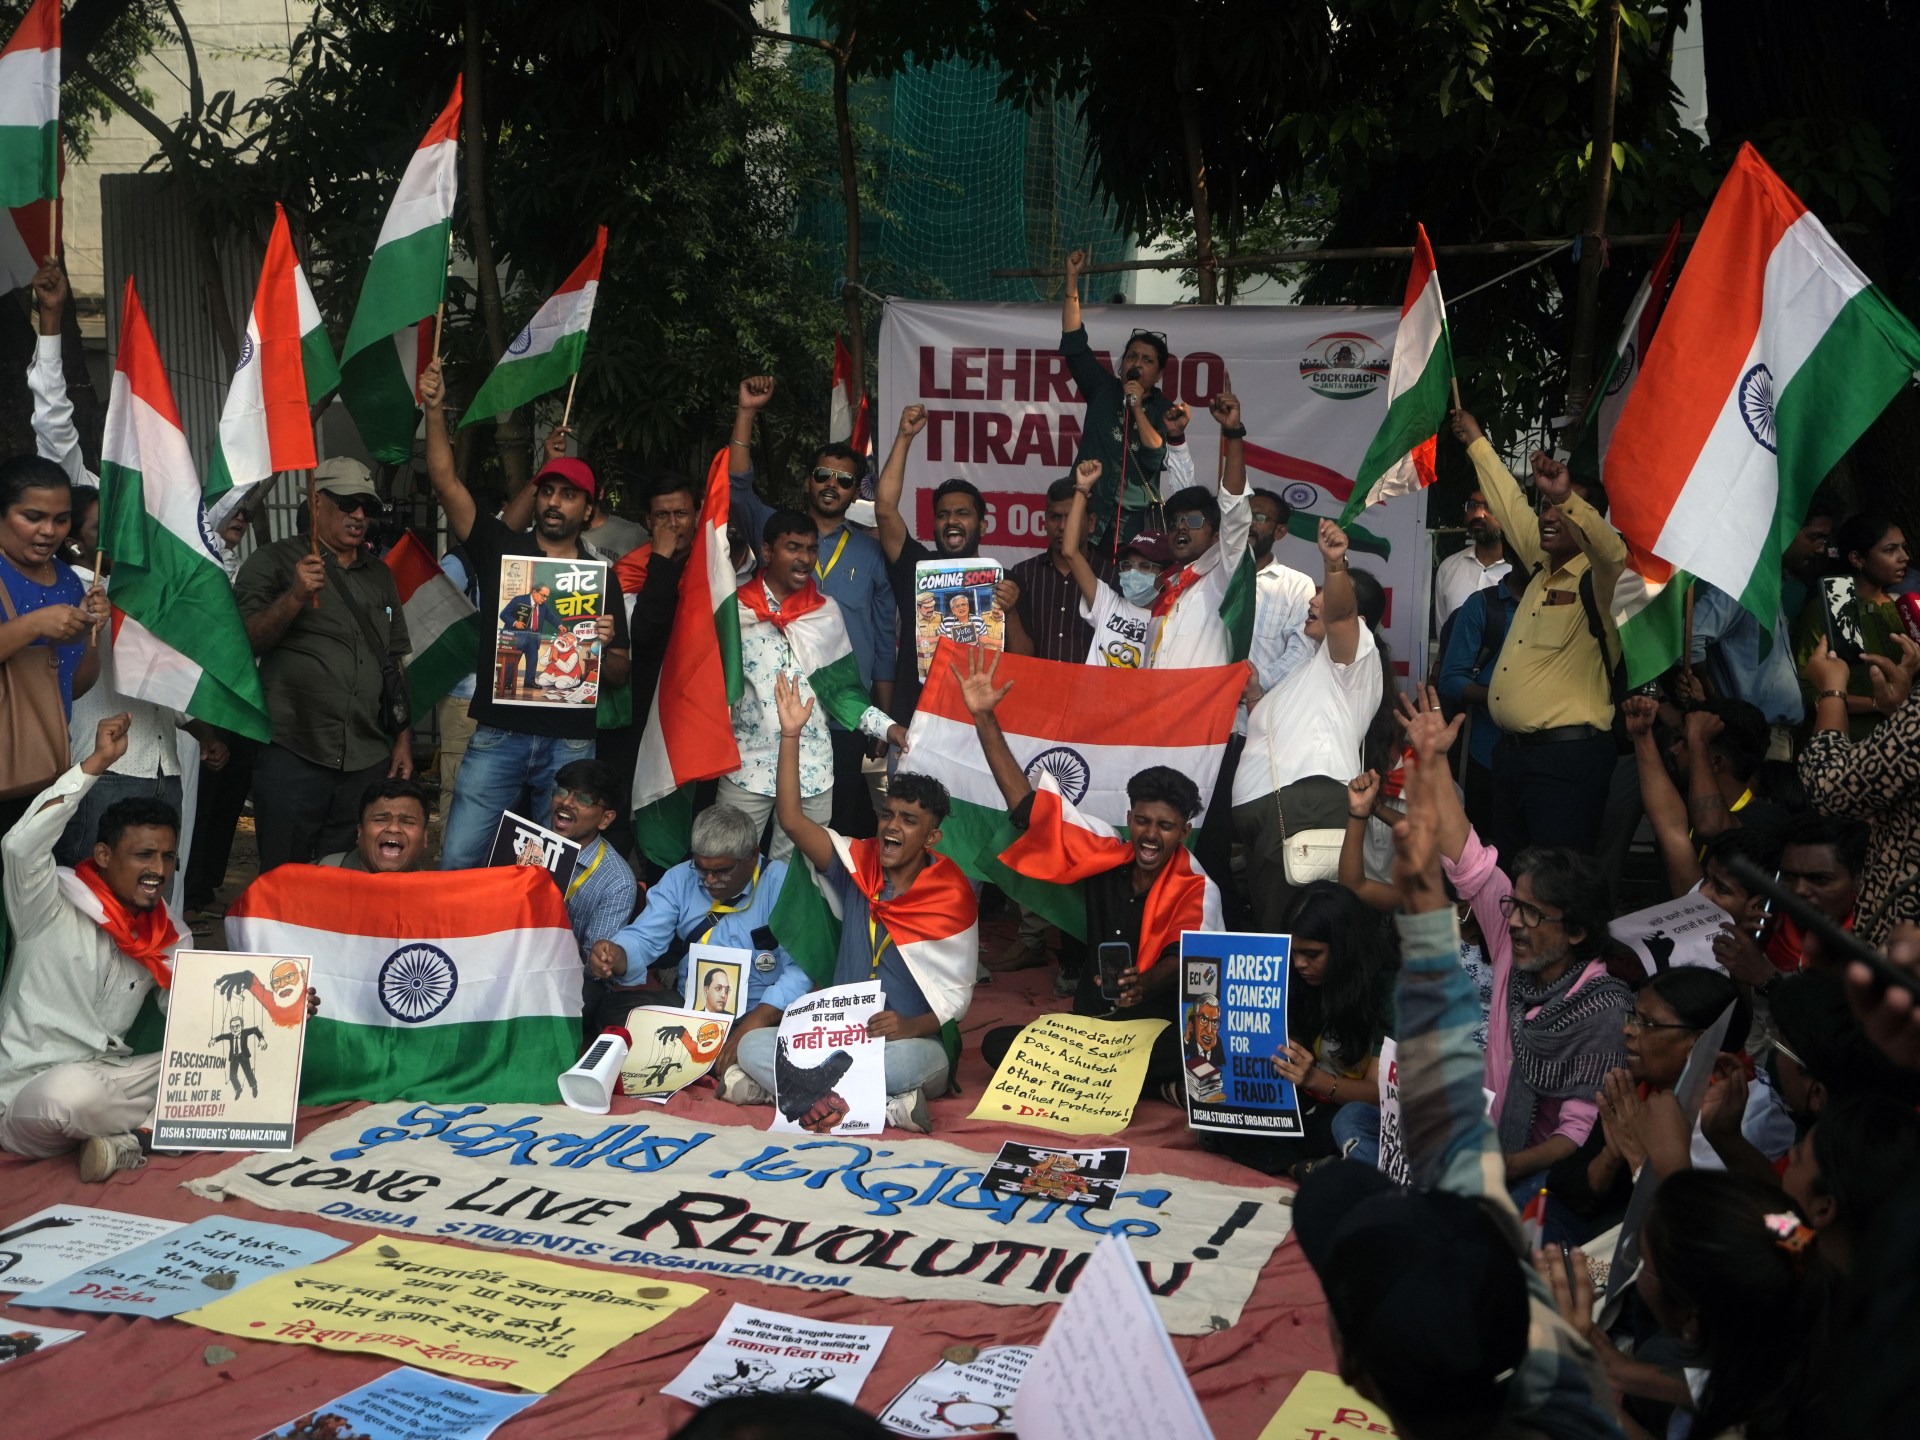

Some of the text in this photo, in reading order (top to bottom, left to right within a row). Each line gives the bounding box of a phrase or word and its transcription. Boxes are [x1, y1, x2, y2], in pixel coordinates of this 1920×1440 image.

[1313, 373, 1377, 383] COCKROACH
[555, 565, 598, 593] वोट
[919, 569, 1000, 590] COMING SOON!
[555, 591, 600, 617] चोर
[955, 627, 972, 635] Vote
[1226, 954, 1283, 982] ARREST
[1190, 972, 1201, 986] ECI
[786, 994, 876, 1018] असहमति और विरोध के स्वर
[1227, 984, 1281, 1009] GYANESH
[812, 1012, 844, 1022] का दमन
[1227, 1010, 1271, 1034] KUMAR
[793, 1026, 827, 1049] नहीं
[1030, 1027, 1084, 1049] release
[1230, 1036, 1250, 1053] FOR
[169, 1051, 227, 1069] FASCISATION
[1024, 1036, 1118, 1074] Das, Ashutosh
[168, 1071, 202, 1086] OF ECI
[1015, 1050, 1113, 1088] Ranka and all
[1233, 1056, 1287, 1081] ELECTIO
[166, 1089, 222, 1103] WILL NOT BE
[995, 1080, 1054, 1105] detained
[1234, 1080, 1284, 1105] FRAUD!
[165, 1103, 226, 1119] TOLERATED!!
[1017, 1105, 1070, 1122] Disha
[1193, 1108, 1211, 1121] DISHA
[1244, 1114, 1294, 1129] ORGANIZATION
[160, 1126, 186, 1139] DISHA
[230, 1129, 287, 1142] ORGANIZATION
[247, 1157, 441, 1203] LONG
[446, 1176, 632, 1226] LIVE
[204, 1229, 236, 1242] It
[317, 1201, 418, 1229] DISHA
[610, 1249, 852, 1287] ORGANIZATION
[164, 1251, 184, 1262] to
[235, 1254, 286, 1268] voice
[156, 1265, 193, 1280] the
[69, 1283, 157, 1304] Disha
[732, 1327, 755, 1338] अन्य
[803, 1338, 819, 1346] गये
[857, 1342, 871, 1351] को
[747, 1318, 772, 1330] सौरव
[798, 1328, 834, 1339] आशुतोष
[726, 1337, 783, 1356] तत्काल
[783, 1345, 820, 1360] रिहा
